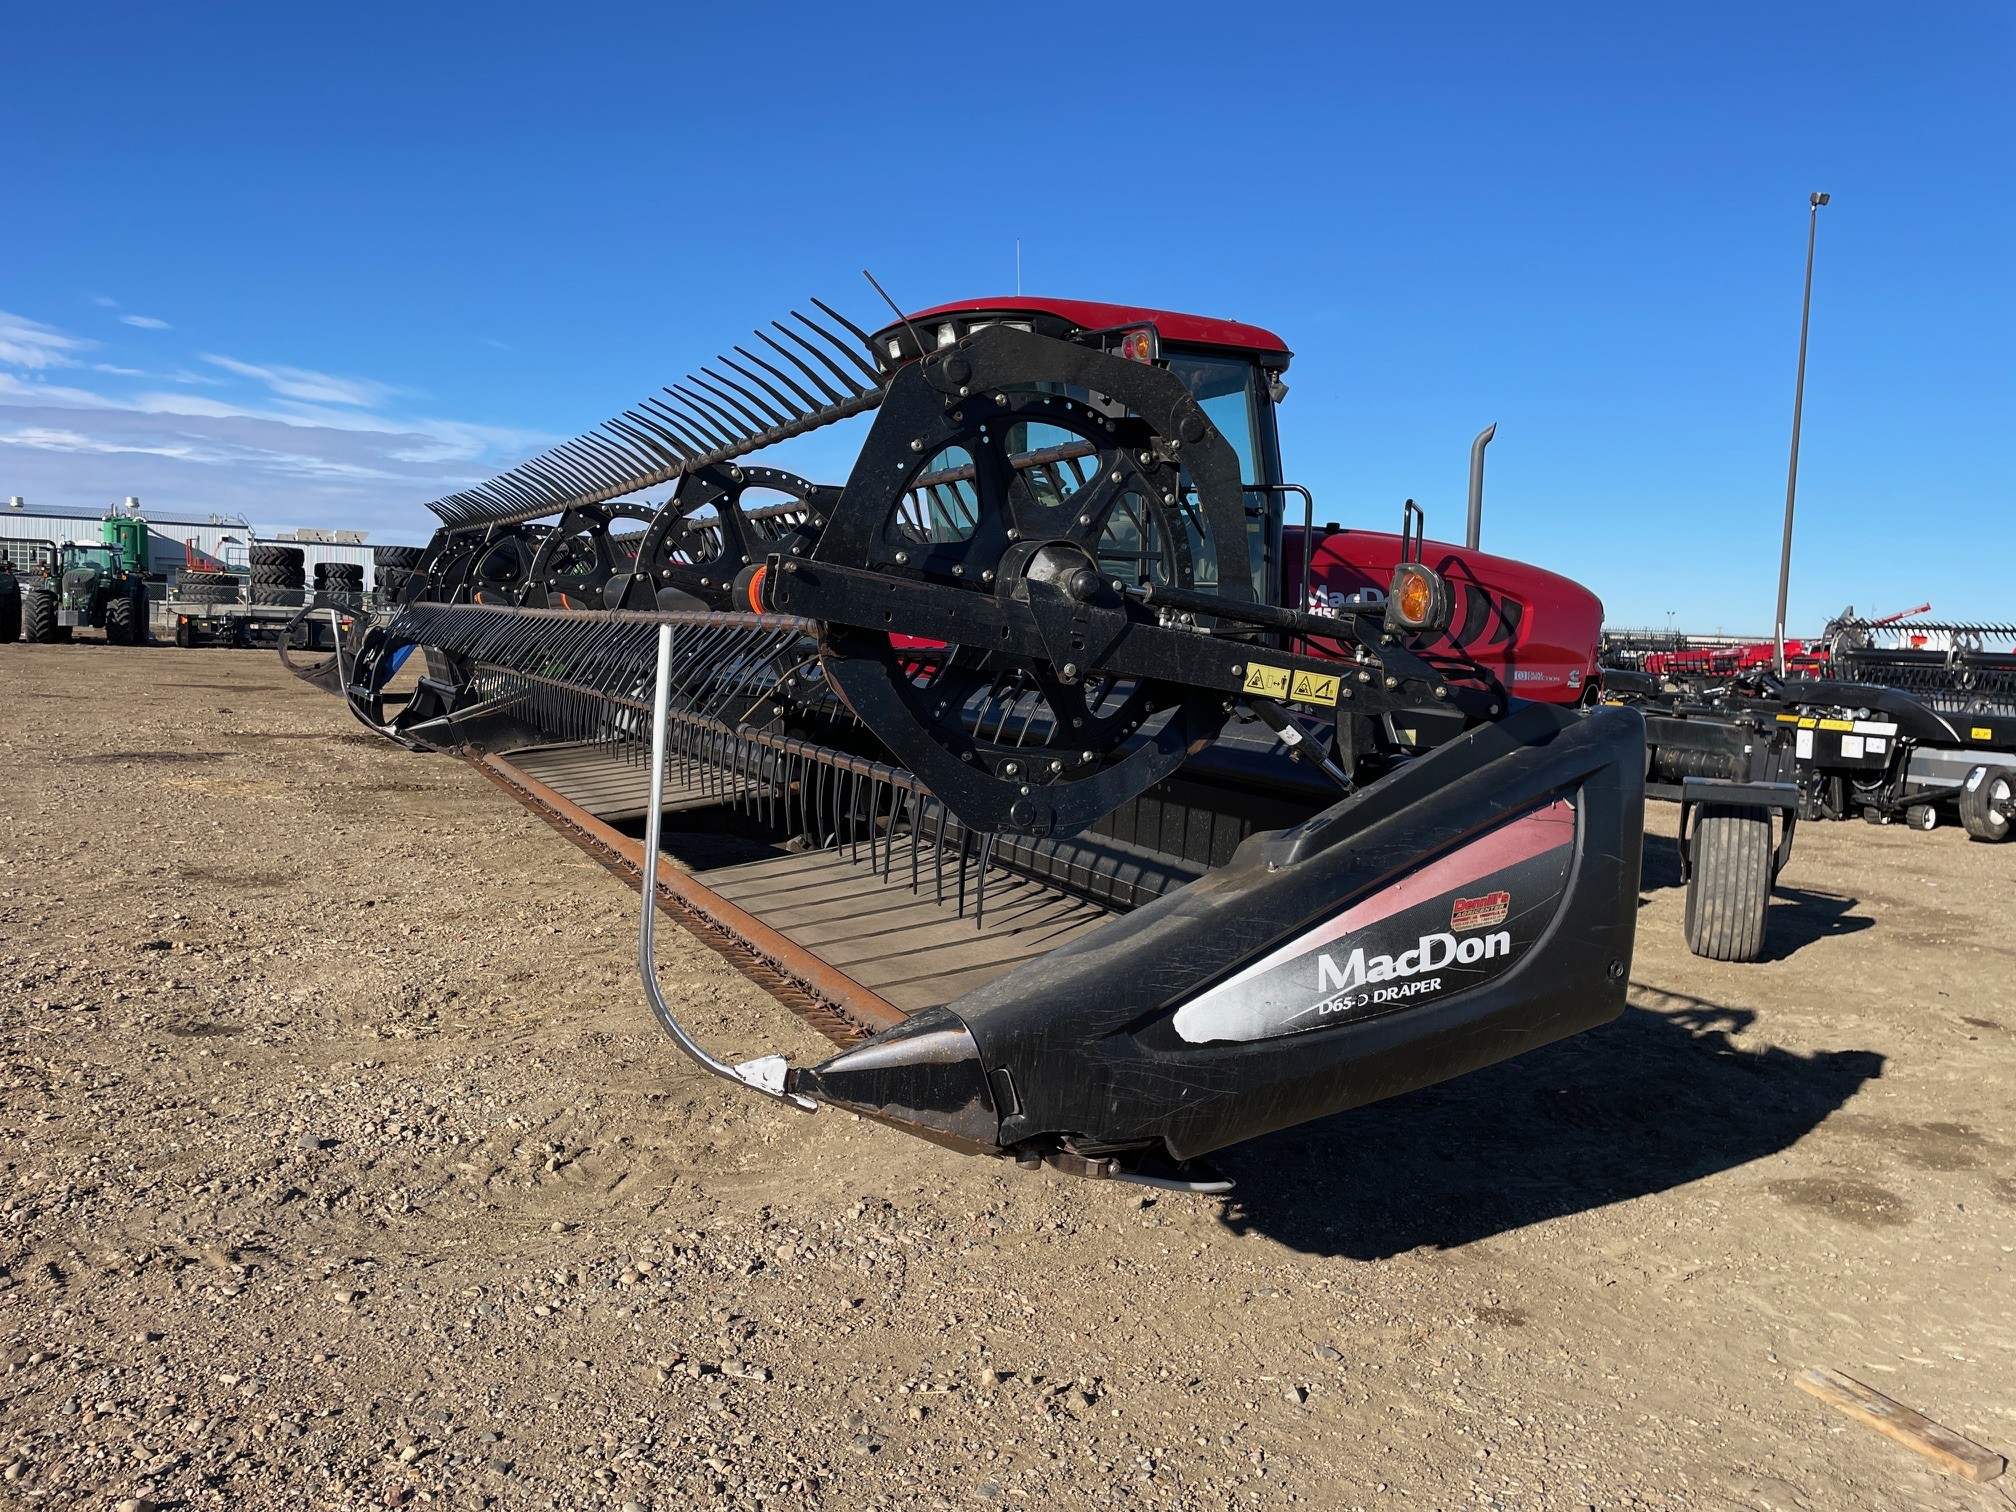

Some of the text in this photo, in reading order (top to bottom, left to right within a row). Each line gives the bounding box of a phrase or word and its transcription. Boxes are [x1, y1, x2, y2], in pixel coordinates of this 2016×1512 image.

[1299, 583, 1390, 608] MacD
[1455, 904, 1505, 918] AGRICENTER
[1318, 931, 1510, 993] MacDon
[1374, 977, 1442, 1003] DRAPER
